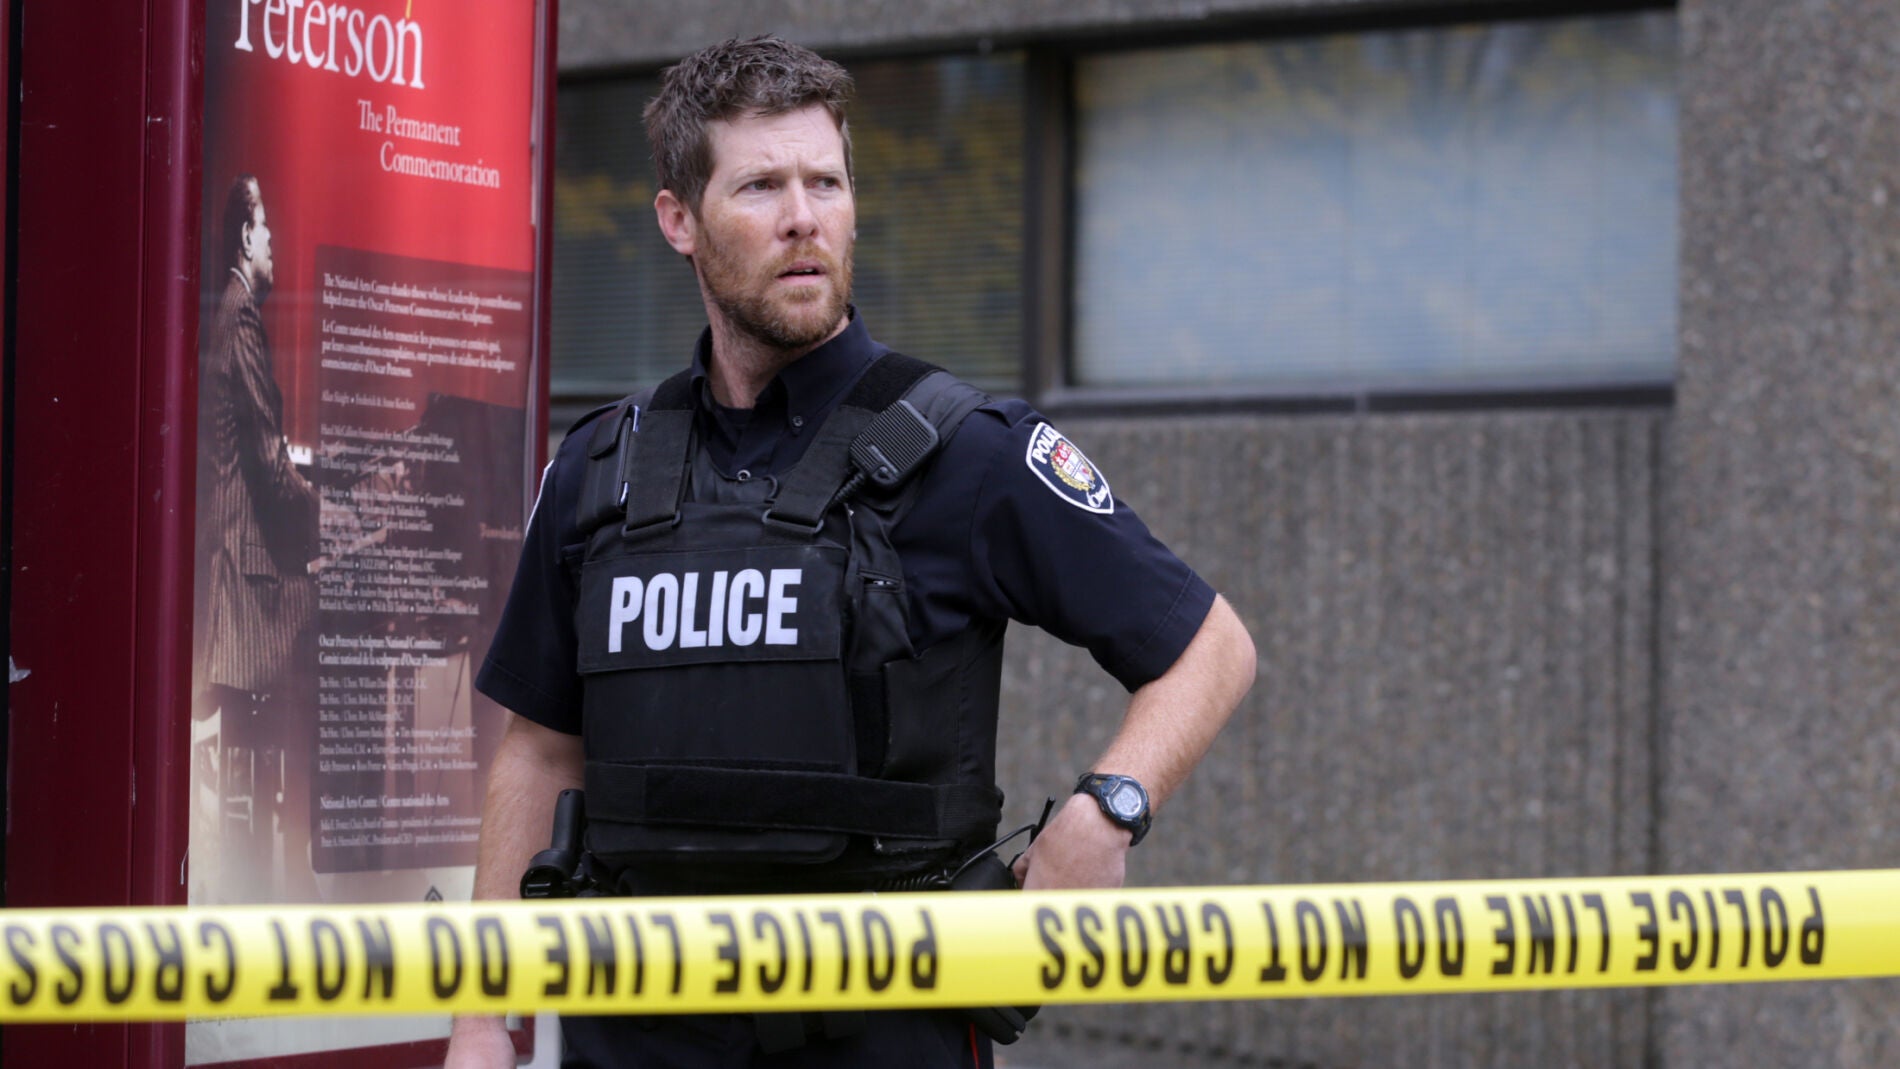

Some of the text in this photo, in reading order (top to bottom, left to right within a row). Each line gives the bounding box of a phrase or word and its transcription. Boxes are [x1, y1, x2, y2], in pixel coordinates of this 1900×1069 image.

[358, 99, 460, 146] The Permanent
[380, 141, 500, 188] Commemoration
[1031, 426, 1058, 465] POLI
[608, 568, 803, 654] POLICE
[4, 909, 939, 1006] POLICE LINE DO NOT CROSS
[1035, 887, 1825, 991] POLICE LINE DO NOT CROSS
